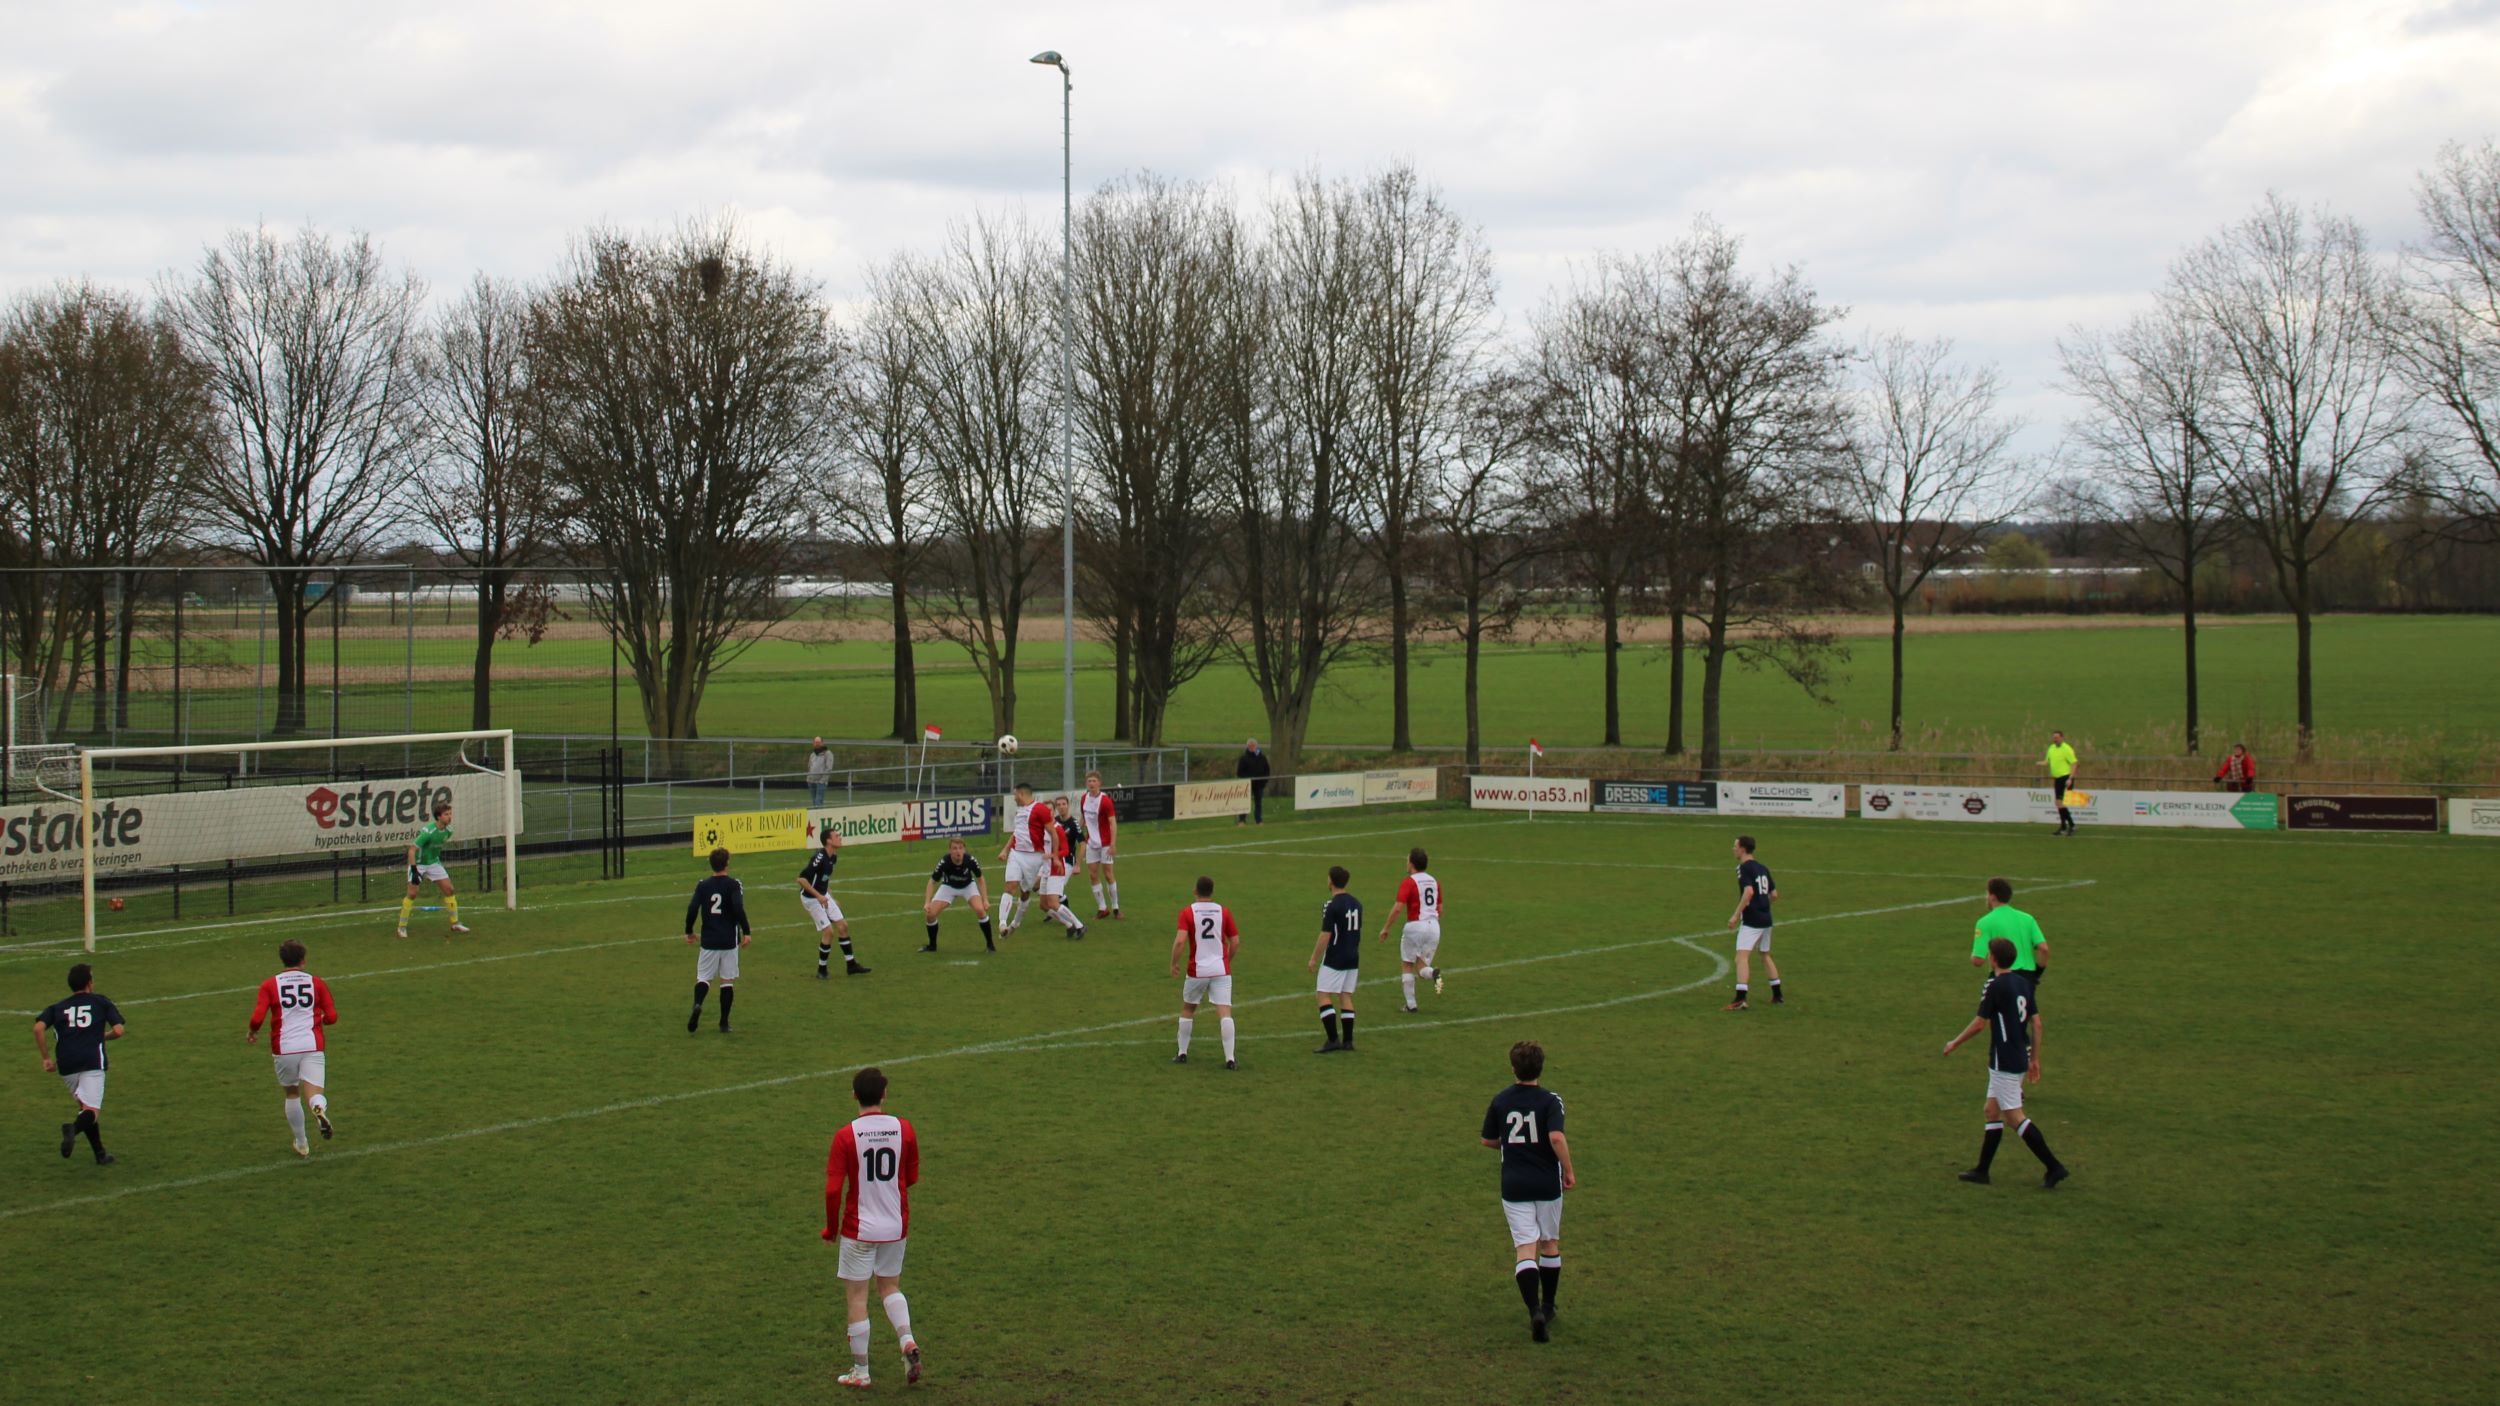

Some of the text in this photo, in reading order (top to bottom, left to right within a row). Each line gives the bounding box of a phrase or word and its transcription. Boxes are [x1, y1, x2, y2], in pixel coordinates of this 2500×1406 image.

[1474, 788, 1588, 803] www.ona53.nl
[1604, 787, 1668, 804] DRESSME
[1750, 787, 1810, 796] MELCHIORS
[902, 798, 985, 829] MEURS
[2163, 802, 2192, 810] ERNST
[0, 801, 143, 856] staete
[820, 814, 897, 837] Heineken
[315, 832, 373, 848] hypotheken
[375, 831, 383, 842] &
[49, 857, 59, 870] &
[61, 853, 142, 868] verzkeringen
[1755, 875, 1769, 895] 19
[710, 893, 722, 914] 2
[1424, 887, 1434, 906] 6
[1201, 918, 1215, 939] 2
[1345, 908, 1359, 931] 11
[281, 983, 313, 1009] 55
[63, 1005, 92, 1028] 15
[2016, 995, 2027, 1023] 8
[1506, 1111, 1538, 1144] 21
[863, 1147, 896, 1181] 10
